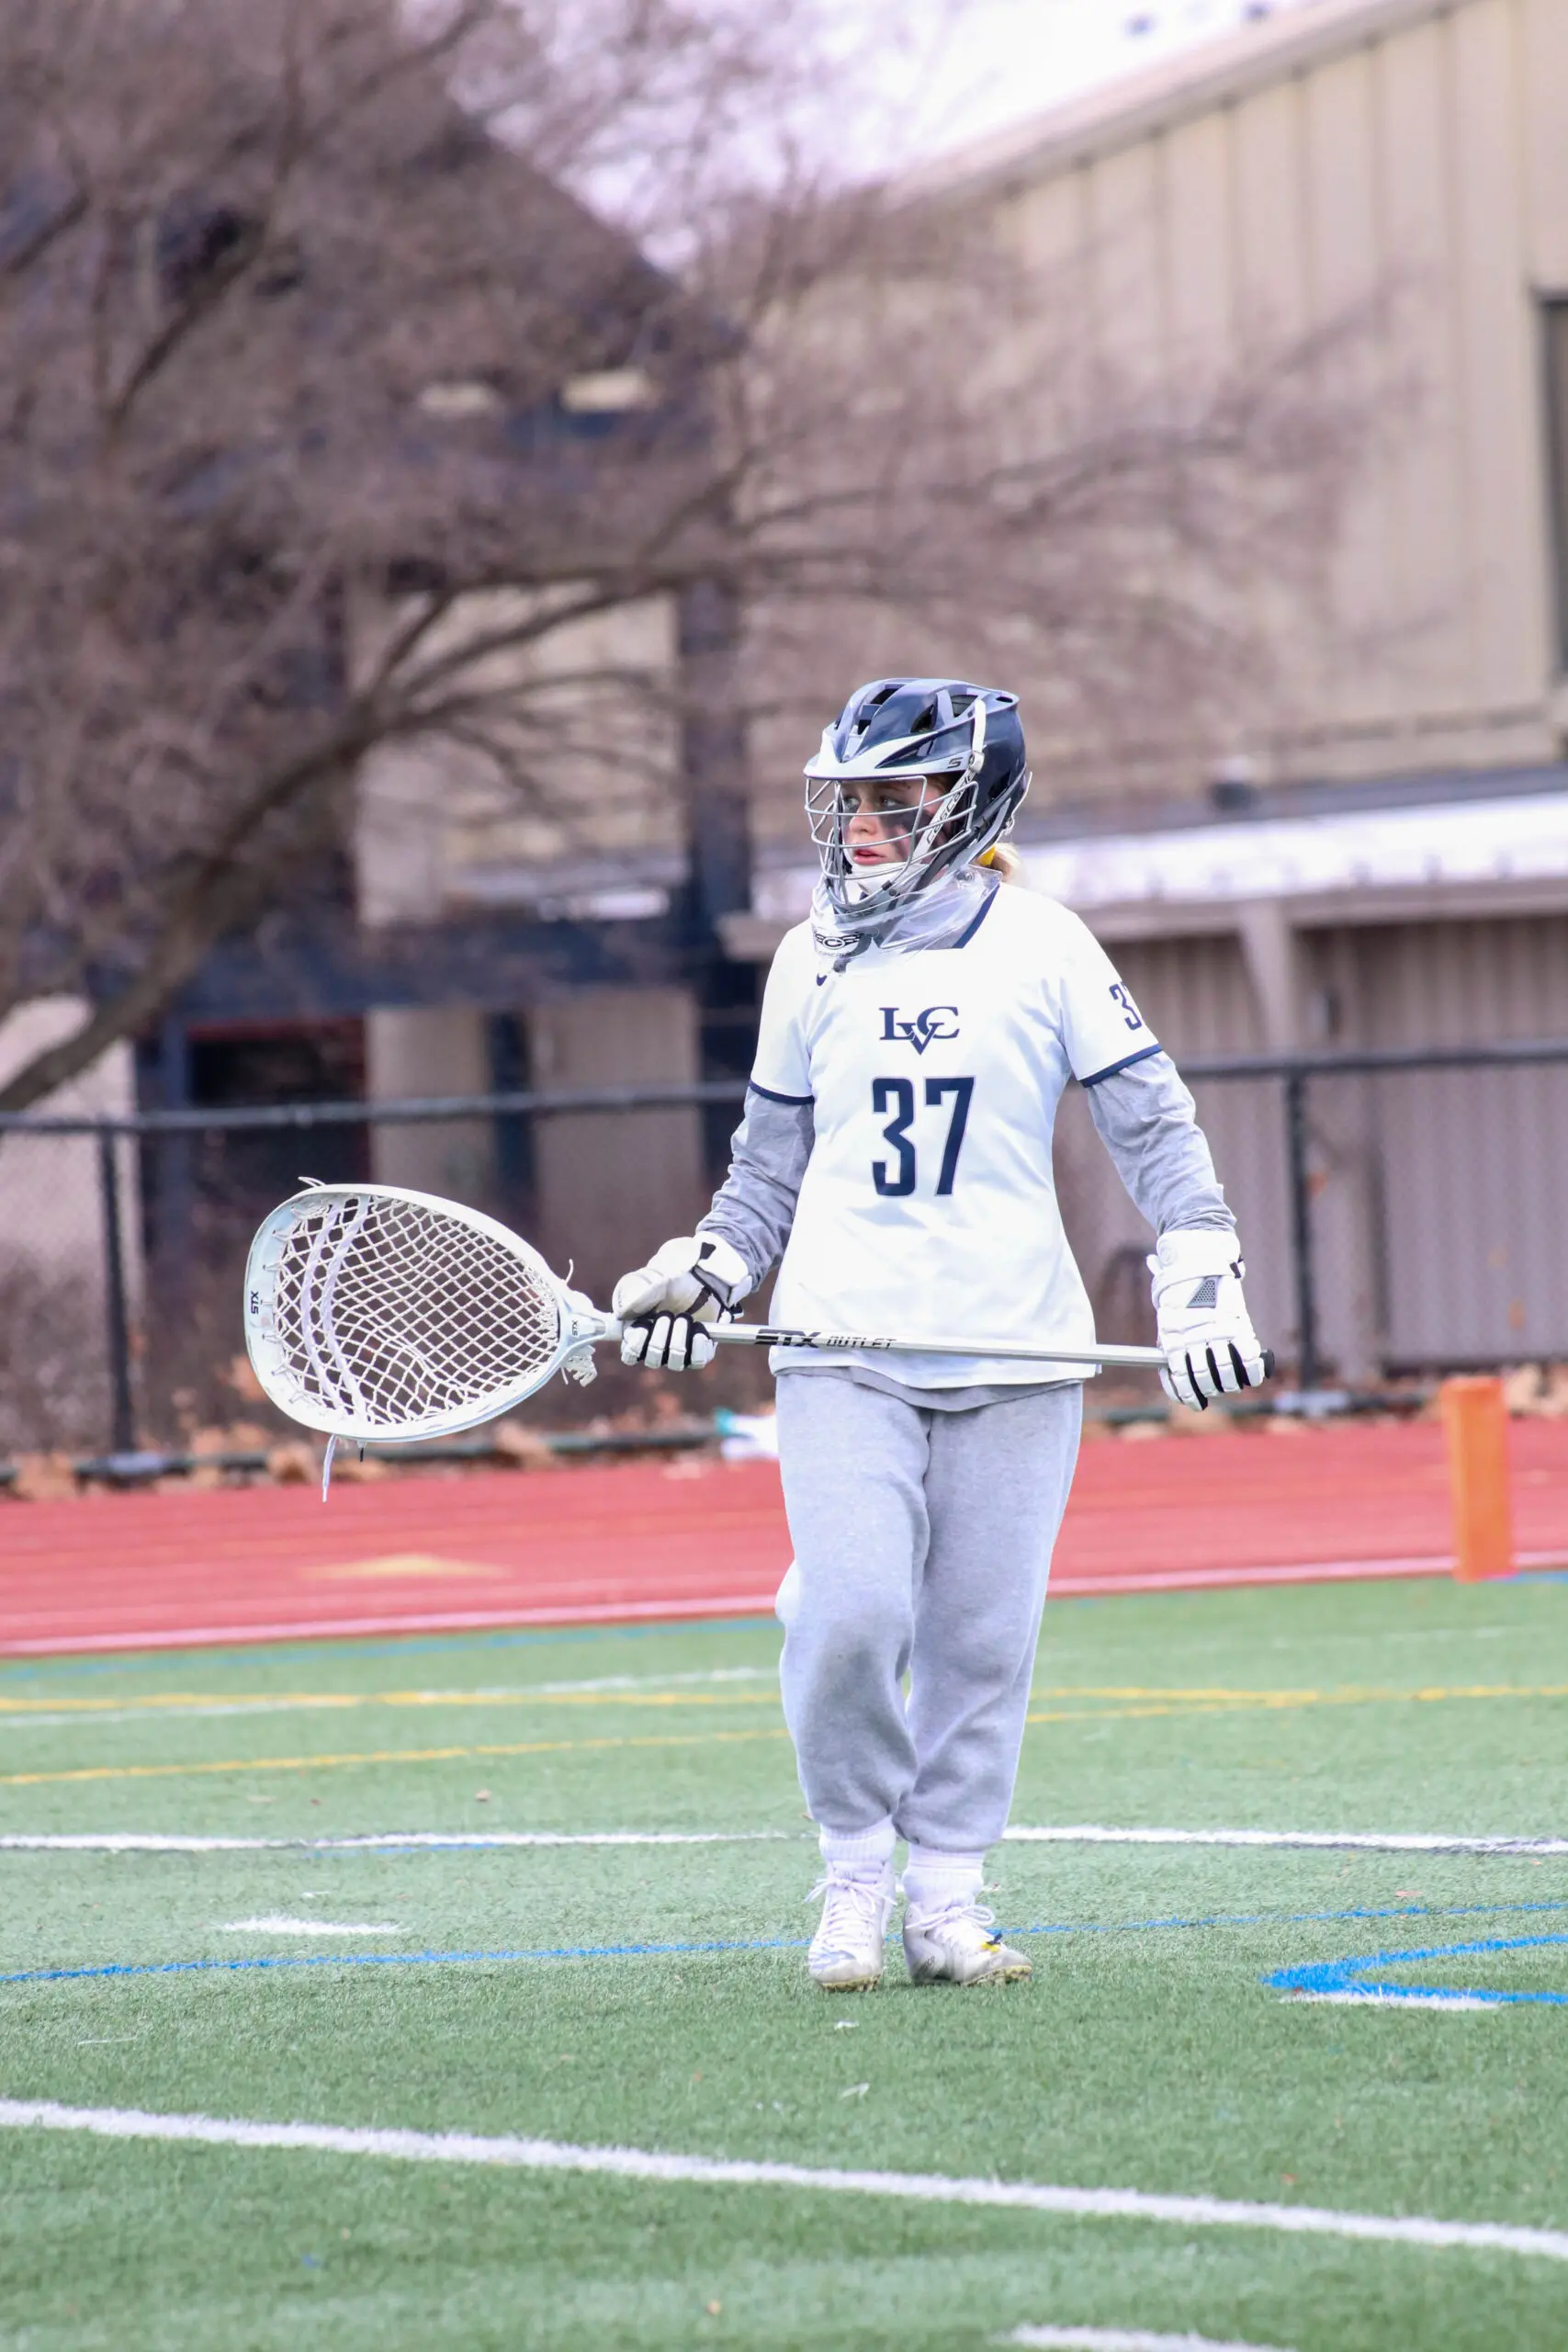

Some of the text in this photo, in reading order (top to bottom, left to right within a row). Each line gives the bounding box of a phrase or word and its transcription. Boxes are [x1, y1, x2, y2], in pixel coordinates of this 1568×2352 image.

[1109, 981, 1143, 1030] 3
[879, 1006, 960, 1056] LVC
[872, 1077, 976, 1196] 37
[250, 1291, 259, 1315] STX
[755, 1329, 897, 1350] STX OUTLET
